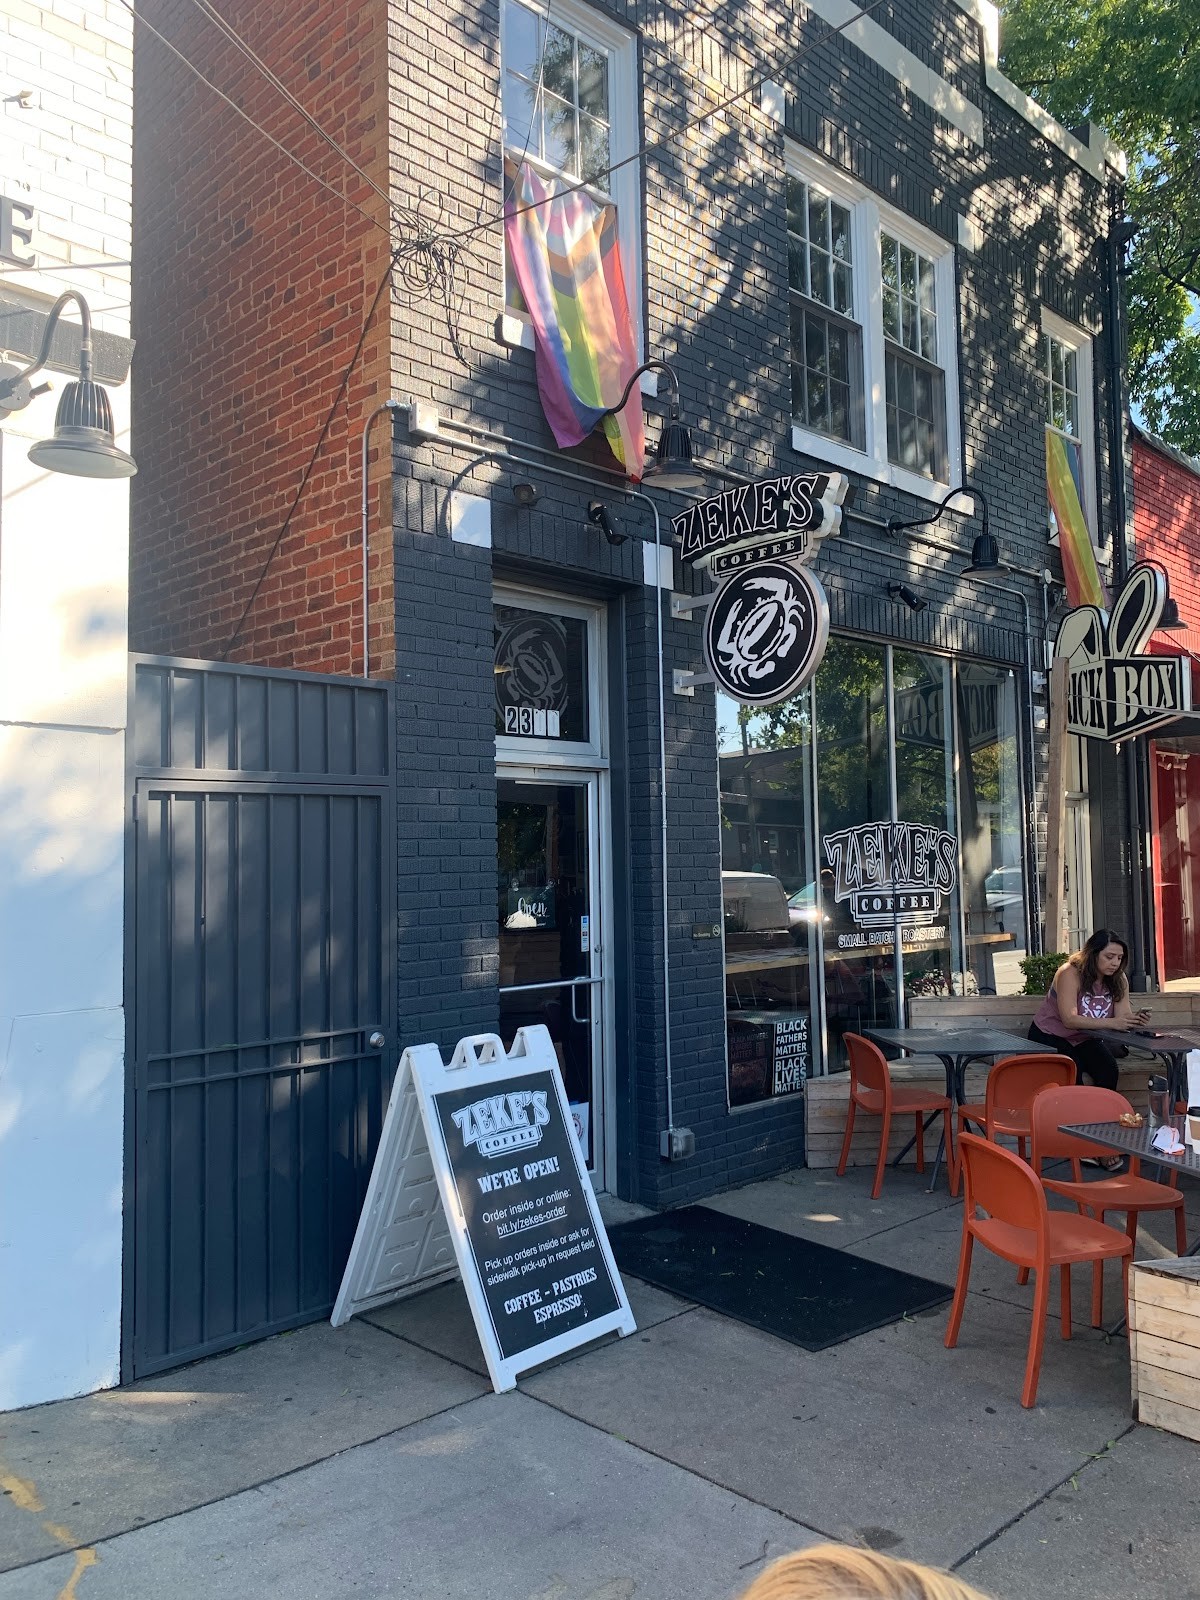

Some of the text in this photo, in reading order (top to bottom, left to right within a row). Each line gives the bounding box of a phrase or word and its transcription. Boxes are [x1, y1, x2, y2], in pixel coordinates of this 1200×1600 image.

[671, 474, 819, 560] ZEKE'S
[719, 539, 796, 568] COFFEE
[1067, 664, 1174, 729] ICK BOX
[823, 822, 957, 902] ZEKE'S
[517, 897, 548, 917] Open
[861, 895, 930, 911] COFFEE
[838, 926, 946, 948] SMALL BATCH ROASTERY
[776, 1019, 807, 1034] BLACK
[776, 1031, 807, 1045] FATHERS
[775, 1042, 807, 1056] MATTER
[775, 1056, 806, 1072] BLACK
[774, 1067, 806, 1085] LIVES
[774, 1080, 806, 1094] MATTER
[451, 1091, 550, 1147] ZEKE'S
[485, 1130, 535, 1149] COFFEE
[477, 1156, 560, 1193] WE'RE OPEN!
[482, 1188, 572, 1224] Order inside or online:
[496, 1205, 567, 1236] bit.ly/zekes-order
[484, 1227, 590, 1271] Pick up orders inside or ask for
[487, 1239, 596, 1286] sidewalk pick-up in request field
[504, 1289, 542, 1315] COFFEE
[552, 1267, 597, 1296] PASTRIES
[533, 1293, 581, 1324] ESPRESSO
